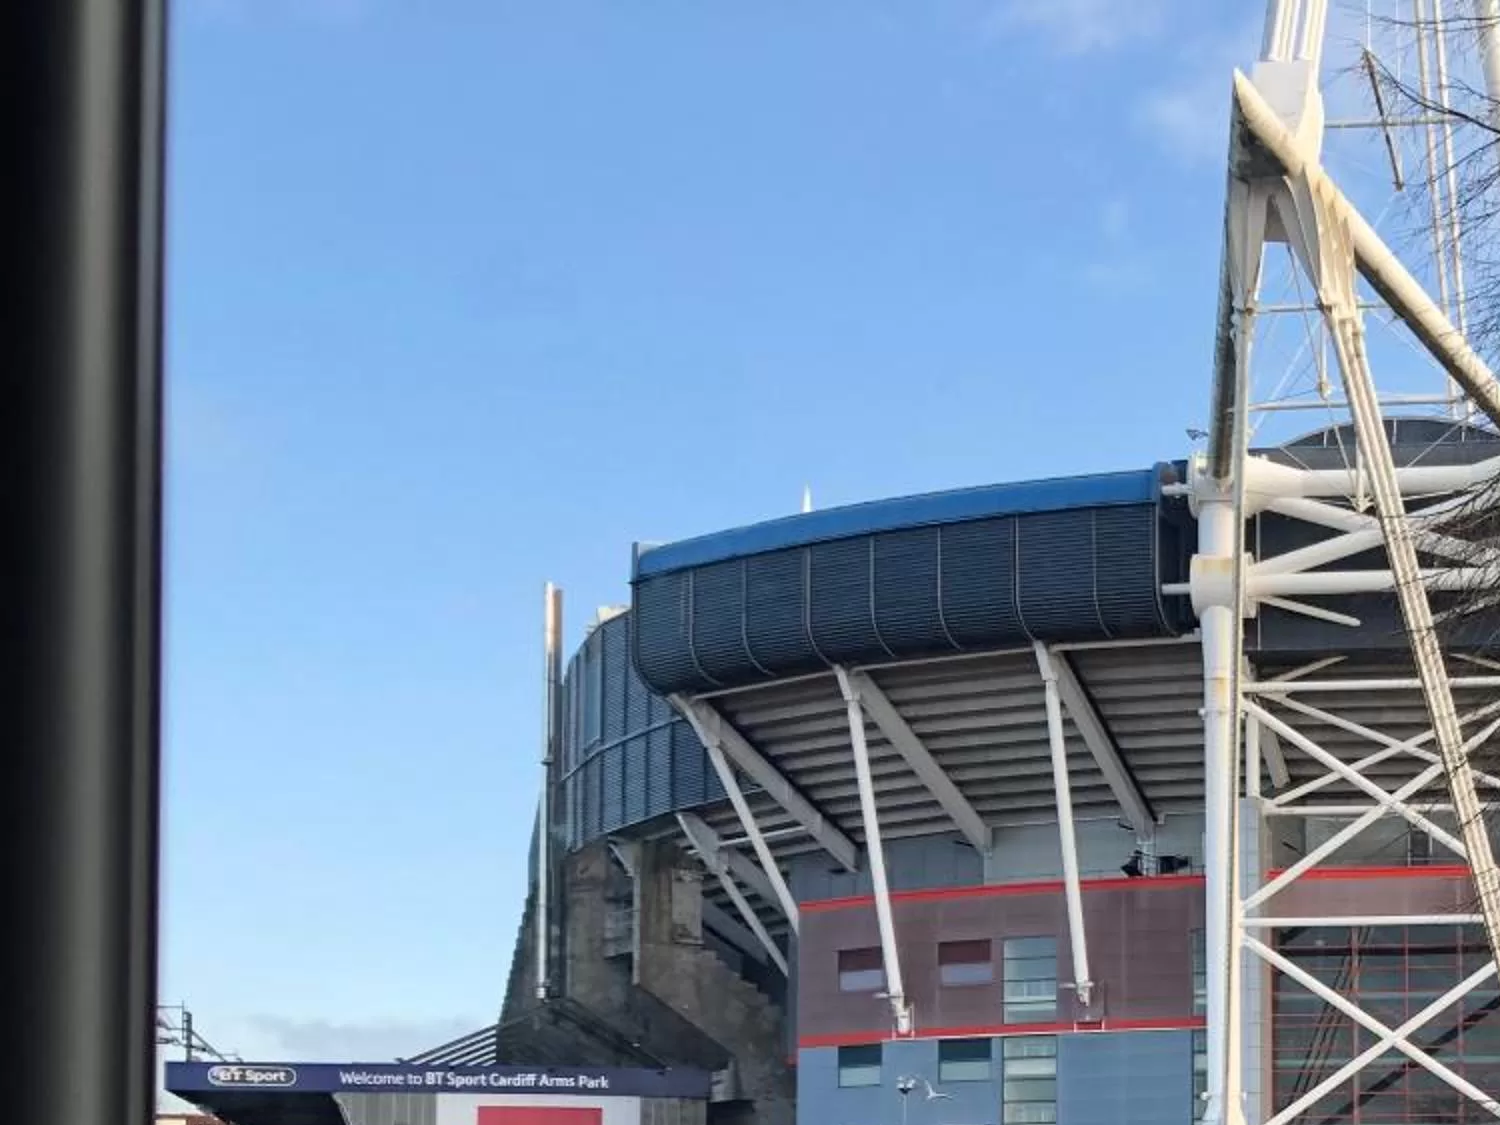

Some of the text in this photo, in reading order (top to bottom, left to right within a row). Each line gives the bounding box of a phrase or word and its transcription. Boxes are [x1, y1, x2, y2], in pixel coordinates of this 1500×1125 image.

[219, 1069, 286, 1083] BT Sport
[340, 1071, 609, 1089] Welcome to BT Sport Cardiff Arms Park
